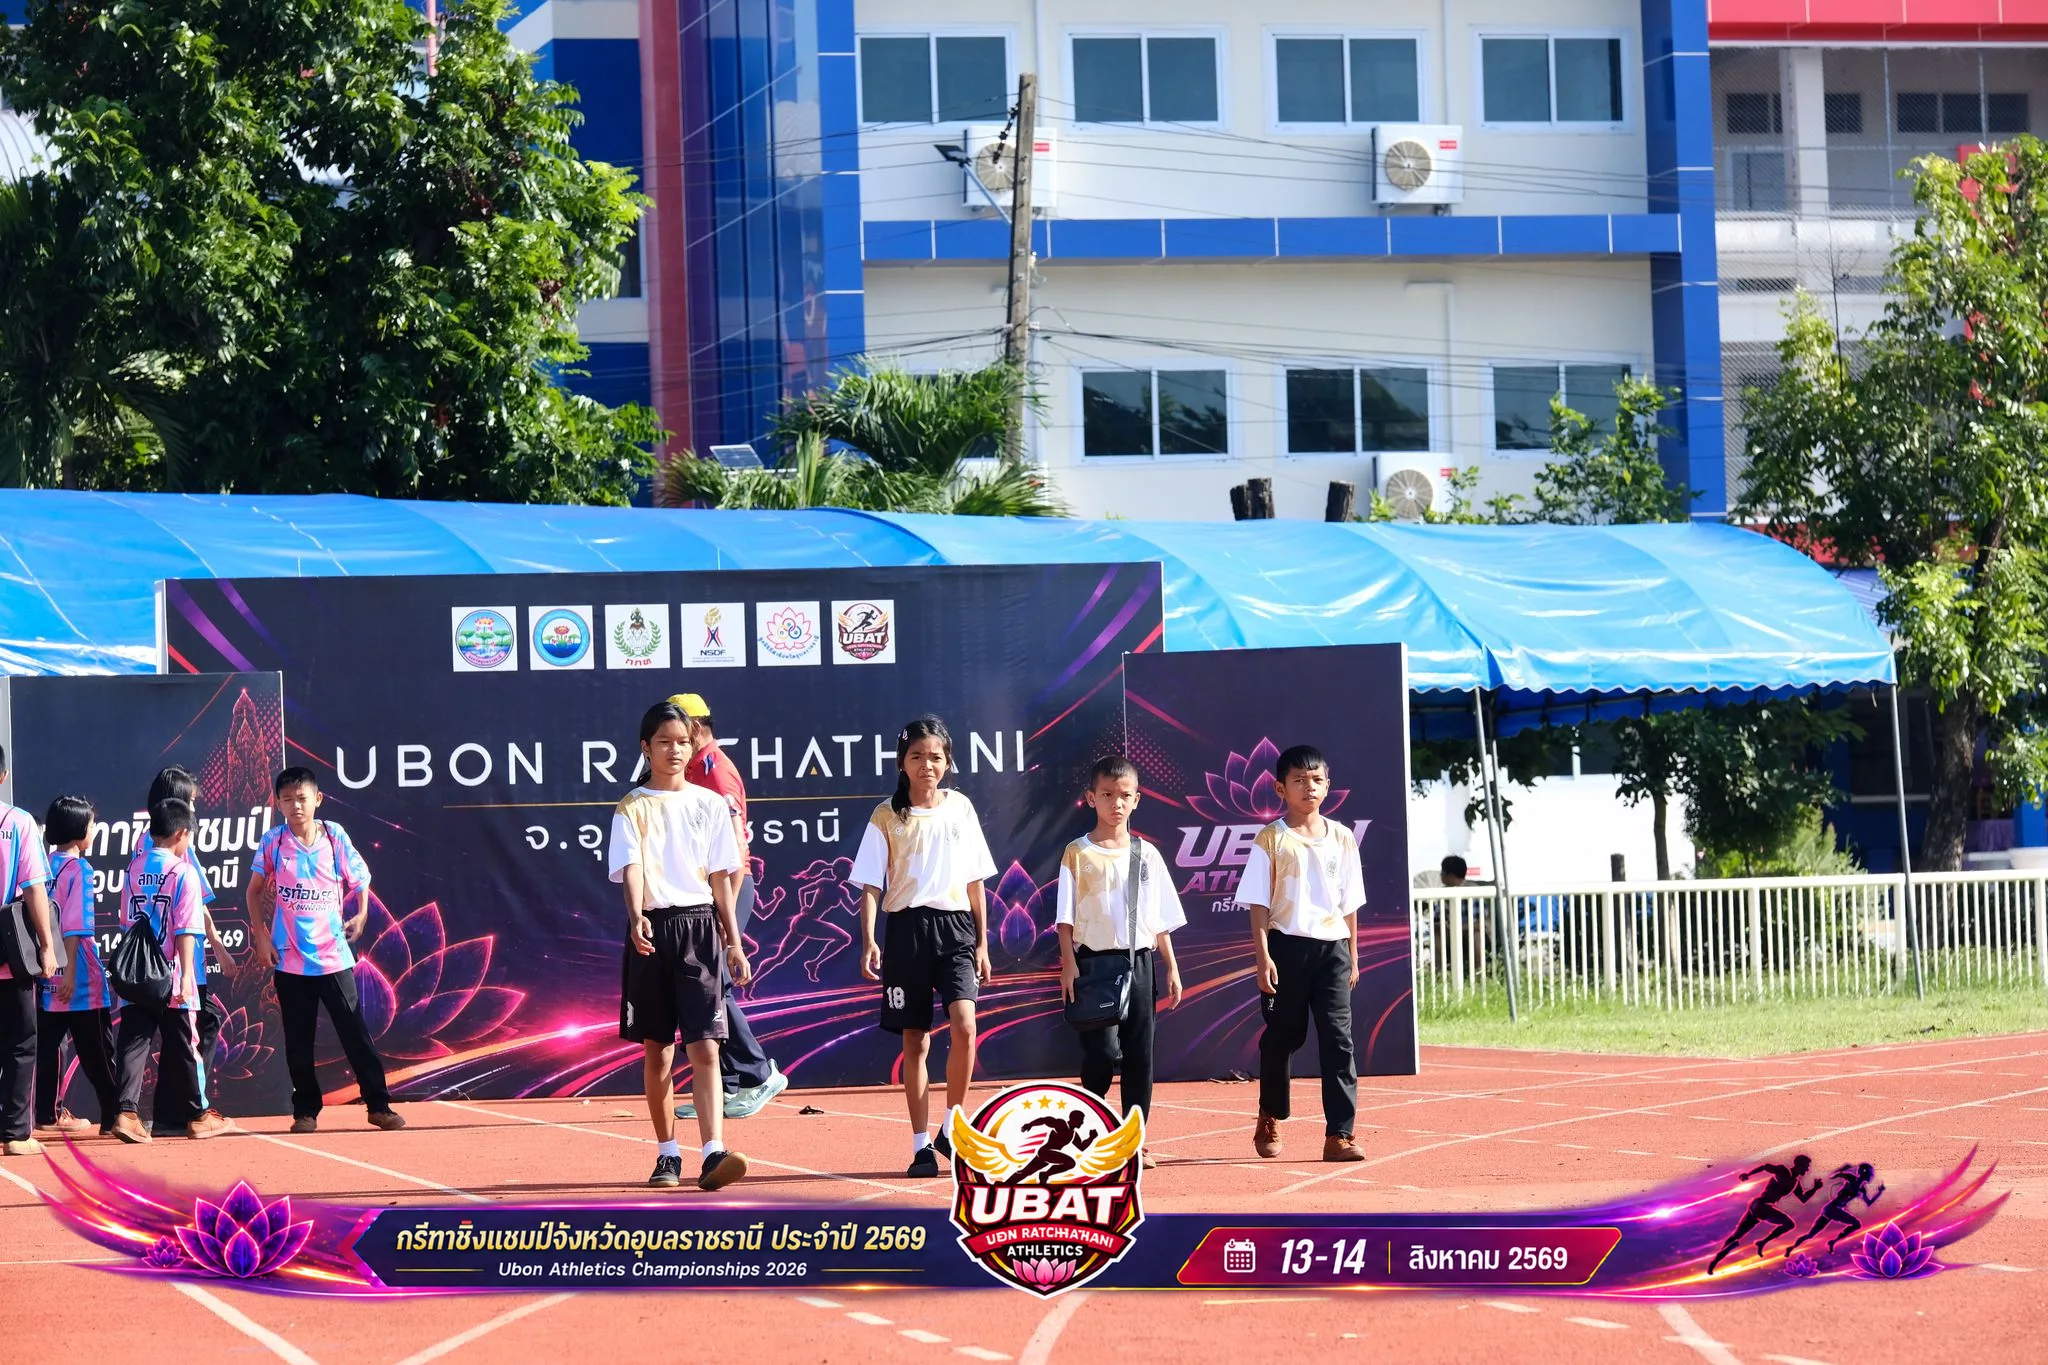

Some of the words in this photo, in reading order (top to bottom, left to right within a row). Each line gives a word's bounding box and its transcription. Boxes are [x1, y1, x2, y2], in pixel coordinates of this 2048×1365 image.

[842, 632, 885, 644] UBAT
[336, 742, 543, 789] UBON
[582, 730, 1025, 783] RHATHNI
[886, 986, 905, 1010] 18
